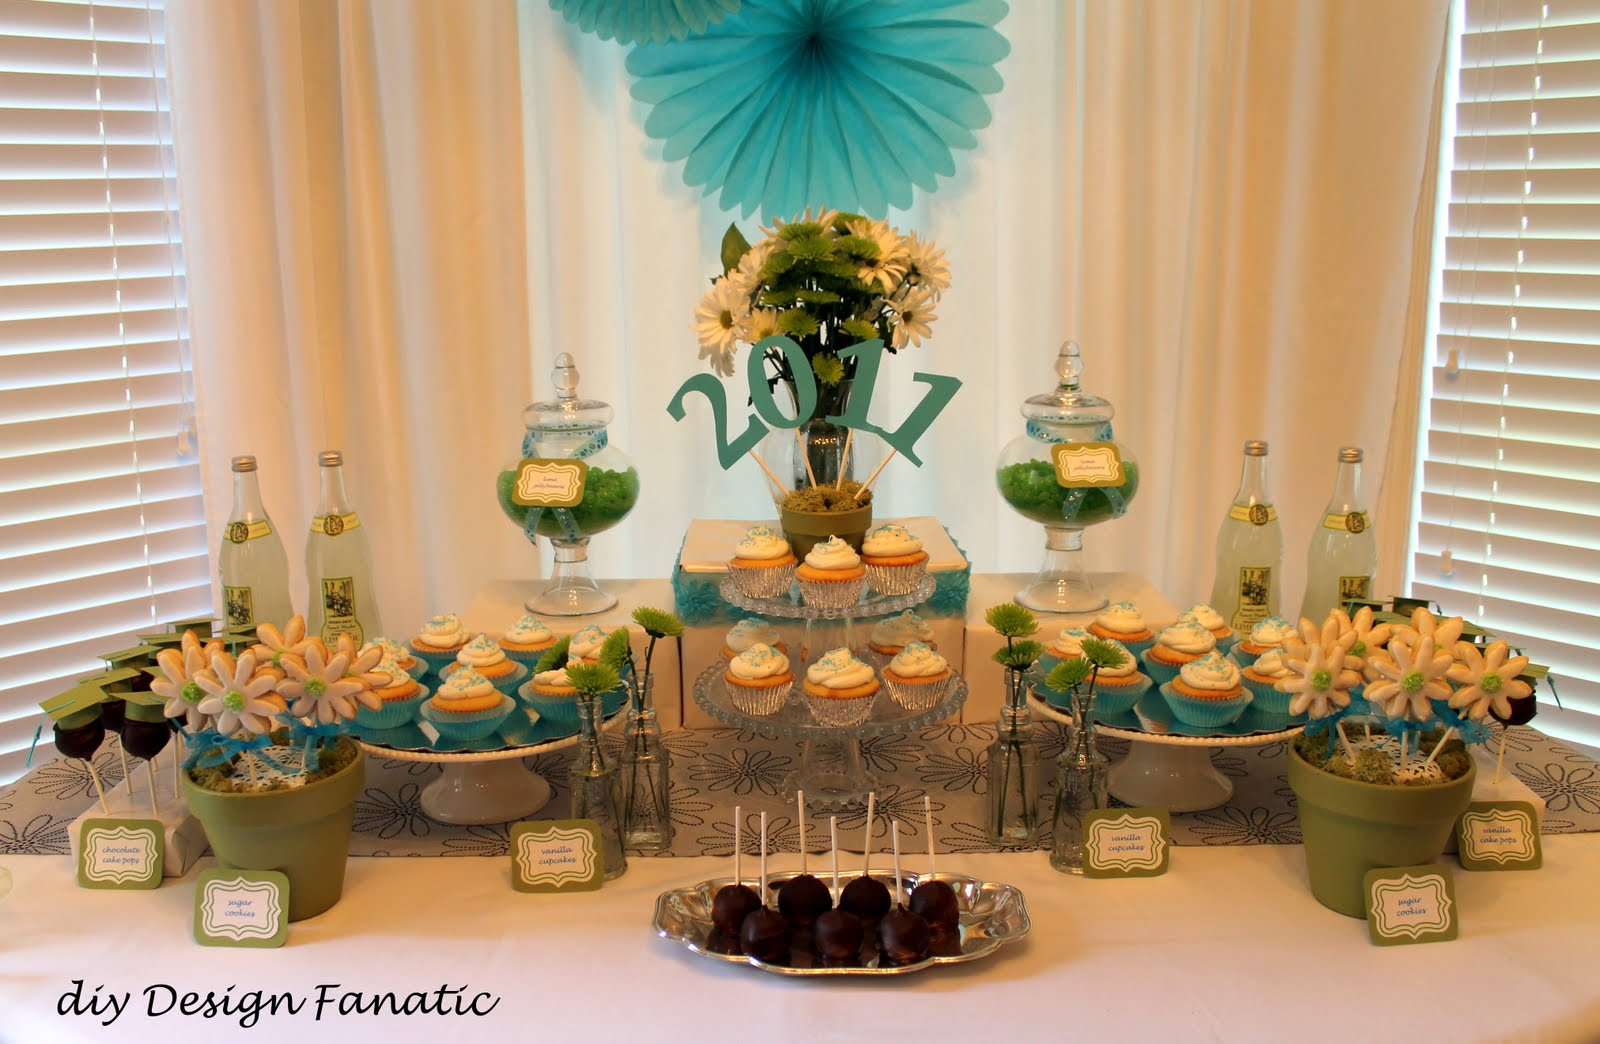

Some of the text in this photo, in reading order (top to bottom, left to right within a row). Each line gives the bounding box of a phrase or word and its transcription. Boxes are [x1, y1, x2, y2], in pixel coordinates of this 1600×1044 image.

[666, 334, 963, 470] 2011
[1482, 826, 1512, 834] vanilla
[1111, 834, 1142, 842] vanilla
[1500, 837, 1516, 845] pops
[541, 846, 573, 854] vanilla
[1108, 844, 1145, 853] cupcakes
[122, 858, 139, 866] pops
[538, 857, 576, 866] cupcakes
[228, 900, 253, 908] sugar
[1398, 897, 1421, 906] sugar
[224, 909, 256, 917] cookies
[1396, 907, 1426, 917] cookies
